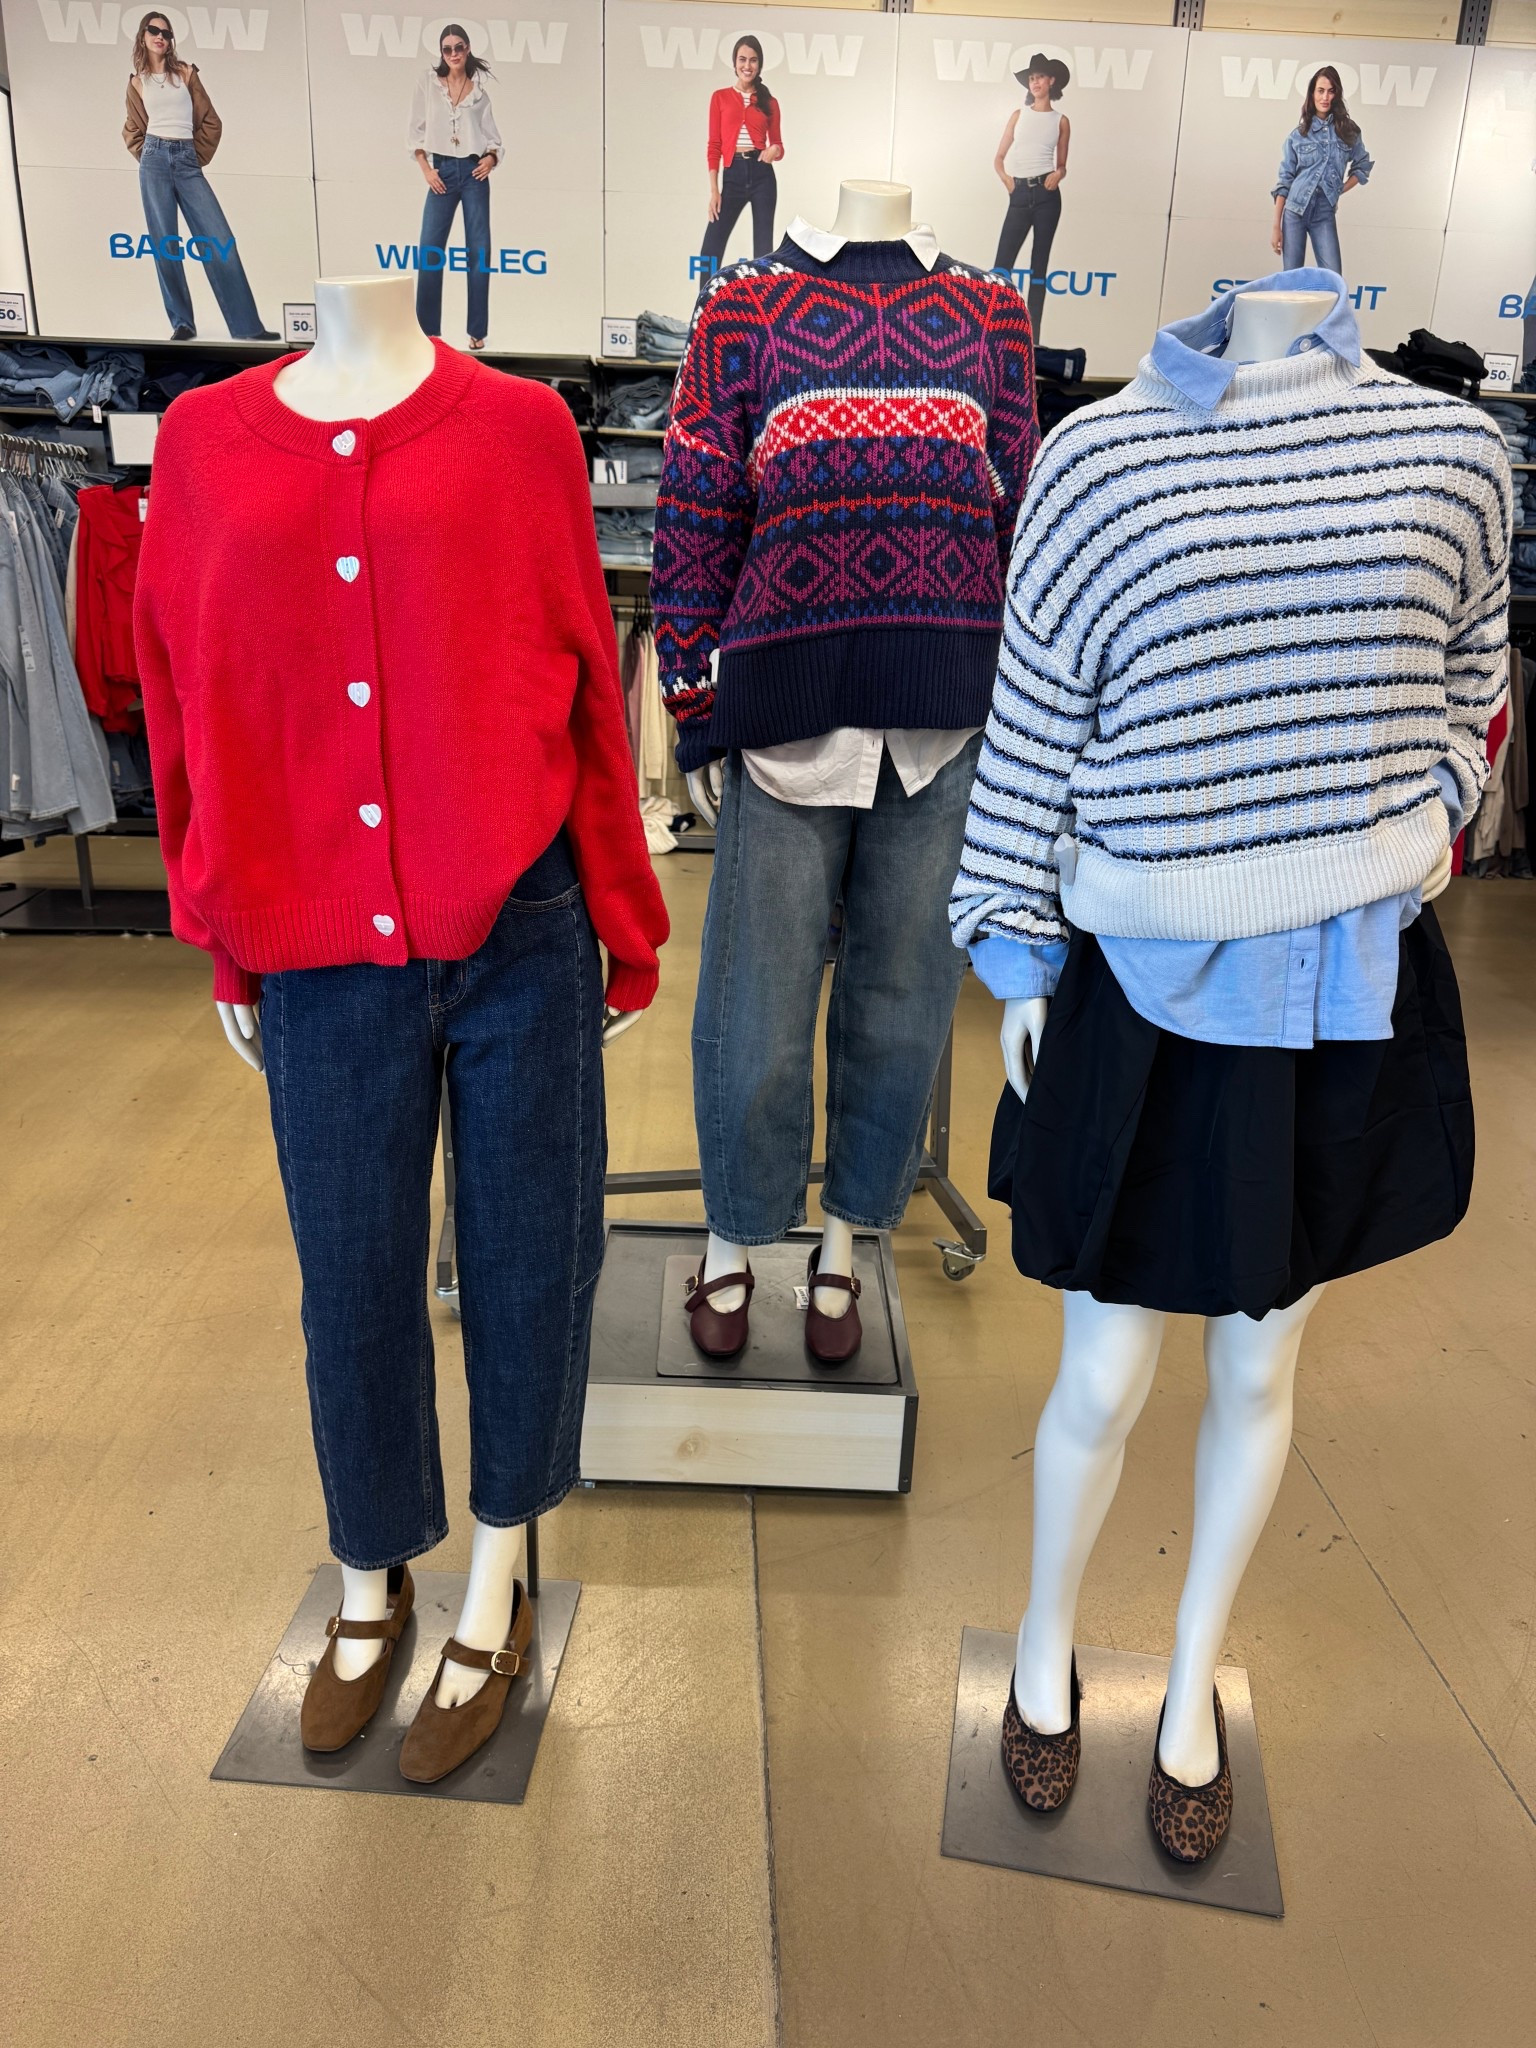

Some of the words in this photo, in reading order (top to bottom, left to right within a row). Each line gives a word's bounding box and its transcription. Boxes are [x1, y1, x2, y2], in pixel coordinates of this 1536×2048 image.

[37, 0, 269, 51] WOW
[340, 12, 569, 64] WOW
[640, 25, 864, 77] WOW
[933, 38, 1153, 91] WOW
[1220, 55, 1438, 108] WOW
[109, 232, 236, 263] BAGGY
[375, 243, 471, 272] WIDE
[477, 247, 547, 275] LEG
[293, 320, 309, 331] 50
[610, 333, 627, 345] 50
[1490, 369, 1507, 381] 50
